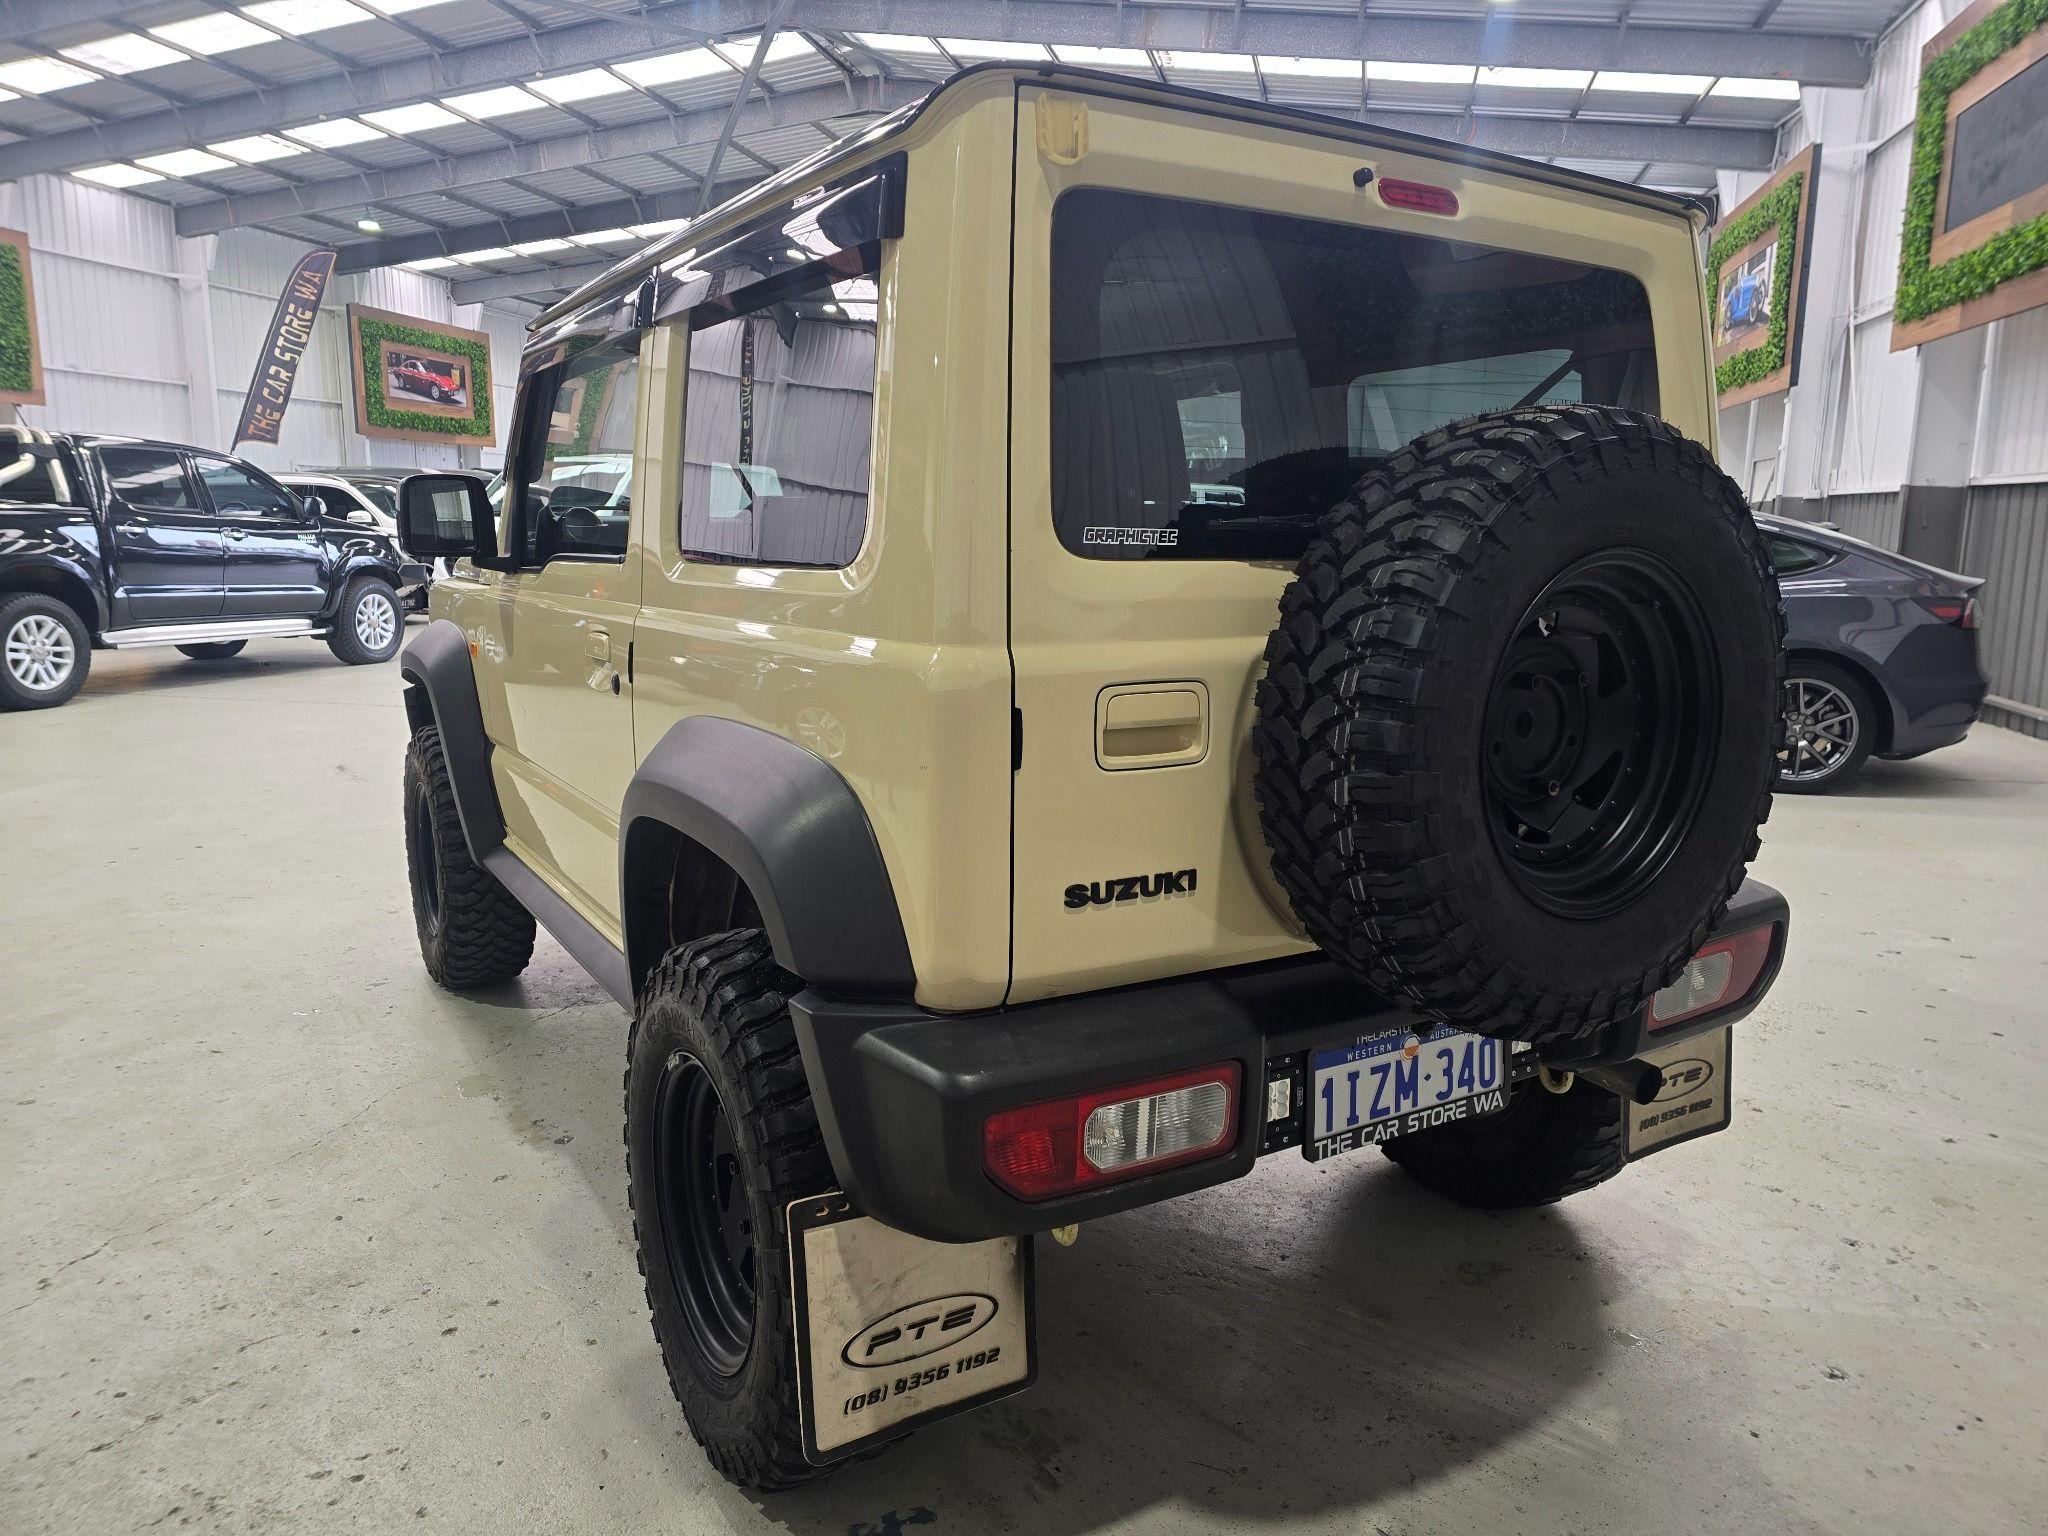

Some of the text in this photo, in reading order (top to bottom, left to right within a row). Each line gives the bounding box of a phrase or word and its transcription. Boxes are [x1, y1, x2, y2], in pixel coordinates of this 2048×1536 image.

[247, 270, 324, 439] THE CAR STORE WA
[1083, 526, 1179, 546] GRAPHICTEC
[1063, 868, 1197, 909] SUZUKI
[1347, 1043, 1392, 1062] WESTERN
[1314, 1089, 1504, 1160] THE CAR STORE WA
[843, 1346, 1001, 1416] (08) 9356 1192
